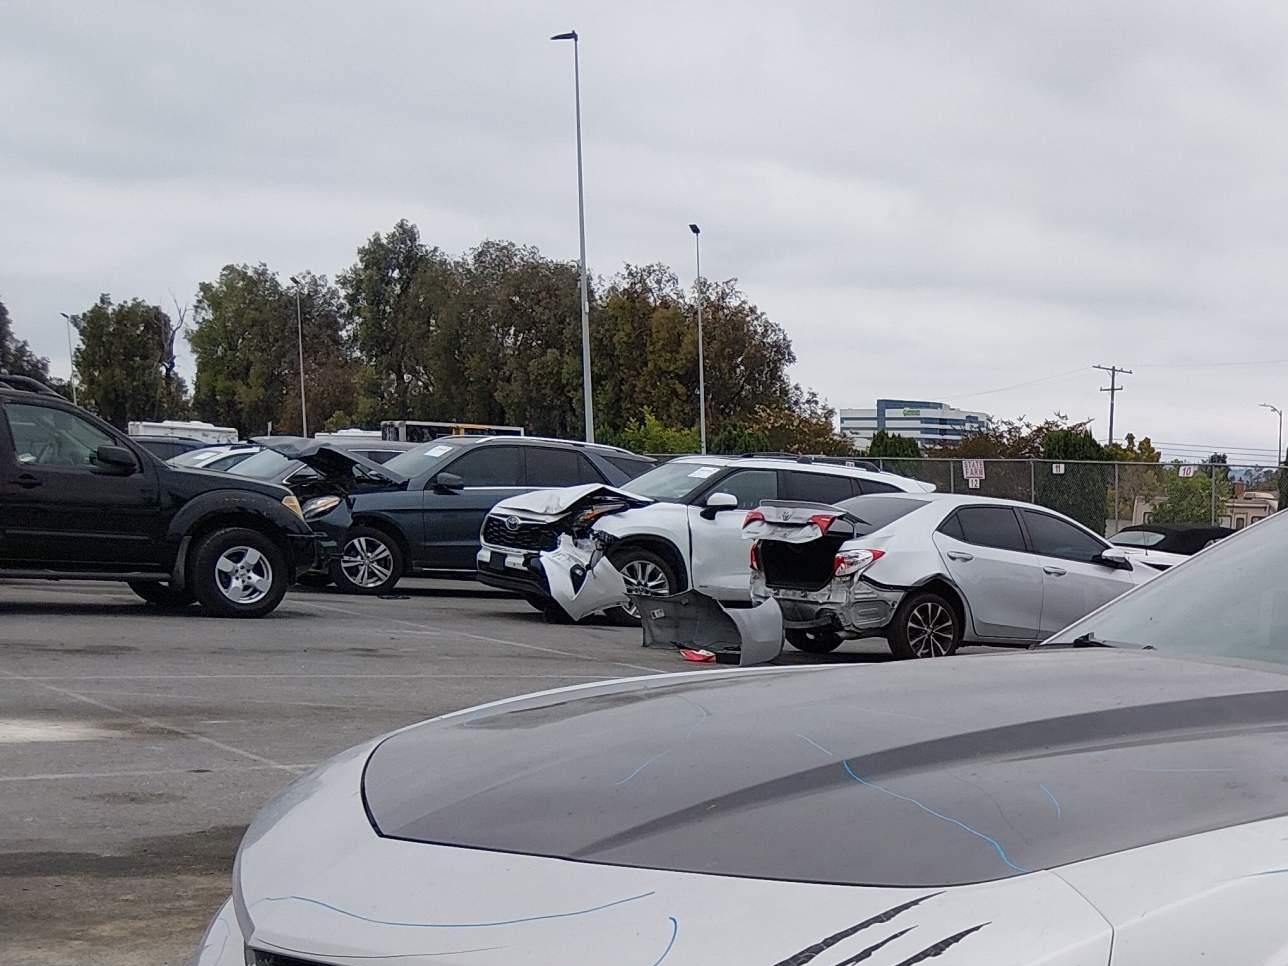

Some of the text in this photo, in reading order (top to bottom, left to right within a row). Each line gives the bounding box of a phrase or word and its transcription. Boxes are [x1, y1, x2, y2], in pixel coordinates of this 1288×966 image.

[964, 460, 984, 468] STATE
[966, 468, 984, 476] FARM
[1183, 466, 1192, 476] 10
[971, 479, 979, 488] 12
